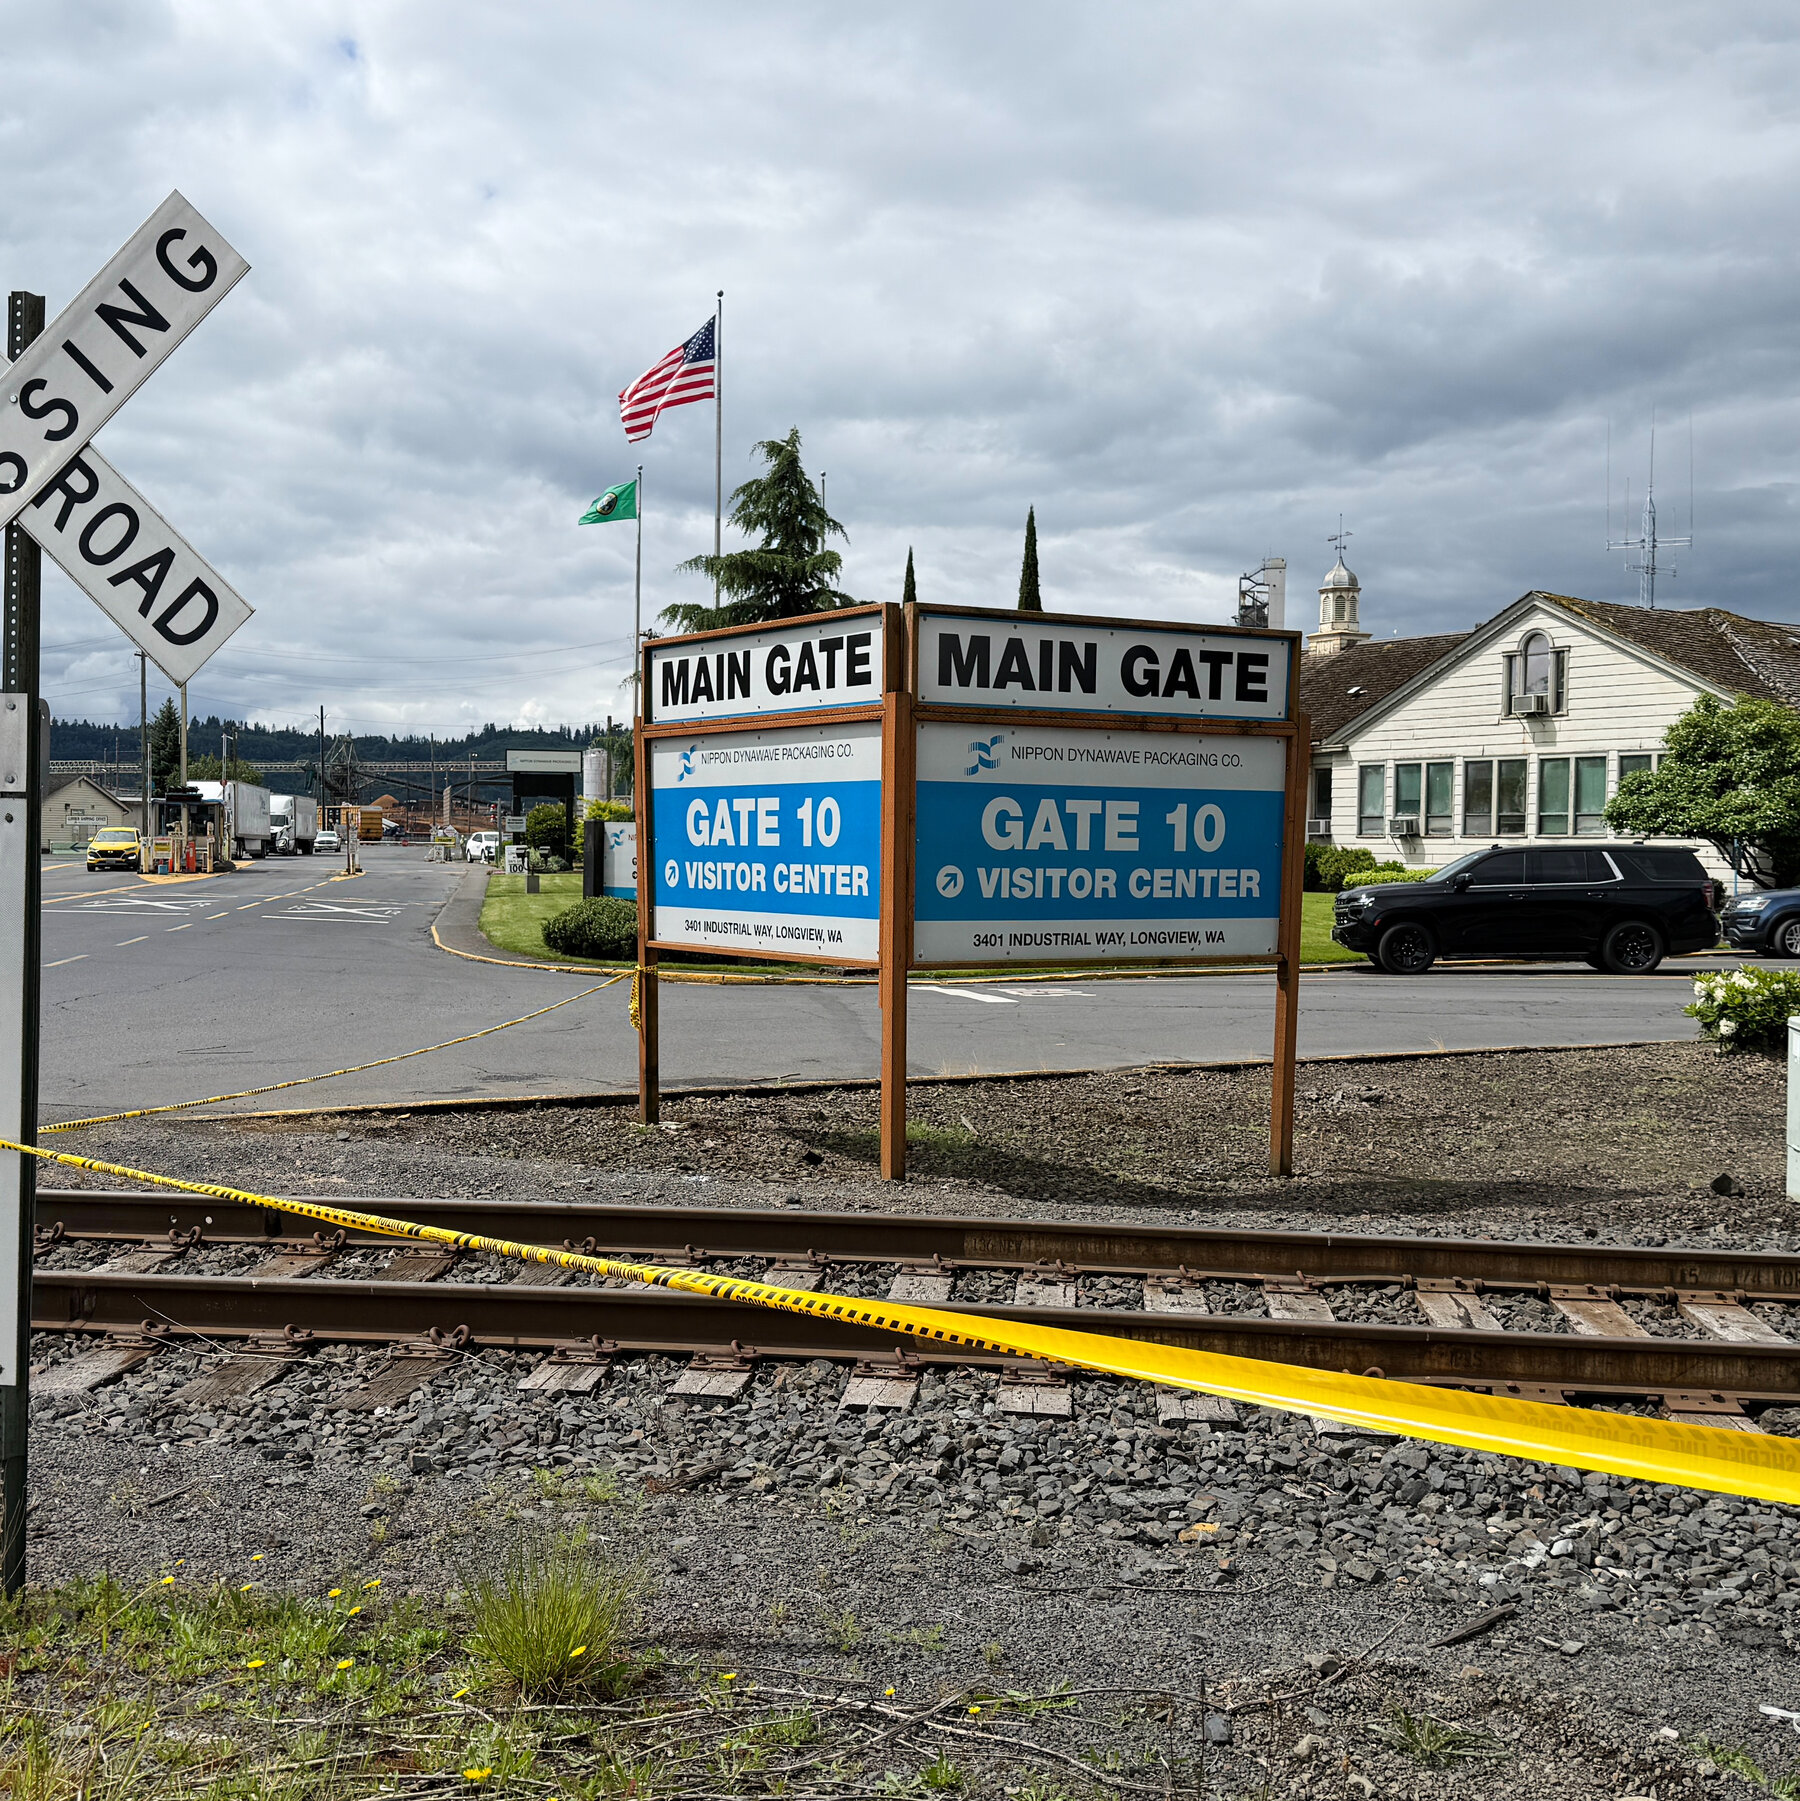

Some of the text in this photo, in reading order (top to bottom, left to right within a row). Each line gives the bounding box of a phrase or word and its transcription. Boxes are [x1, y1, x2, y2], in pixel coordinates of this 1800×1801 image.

[33, 456, 220, 646] ROAD
[662, 632, 872, 707] MAIN GATE
[938, 632, 1269, 703] MAIN GATE
[701, 742, 854, 765] NIPPON DYNAWAVE PACKAGING CO.
[1011, 746, 1243, 768] NIPPON DYNAWAVE PACKAGING CO.
[686, 796, 841, 848] GATE 10
[981, 796, 1226, 853] GATE 10
[685, 861, 869, 896] VISITOR CENTER
[977, 867, 1260, 898] VISITOR CENTER
[684, 919, 843, 943] 3401 INDUSTRIAL WAY, LONGVIEW, WA
[973, 930, 1225, 947] 3401 INDUSTRIAL WAY, LONGVIEW, WA
